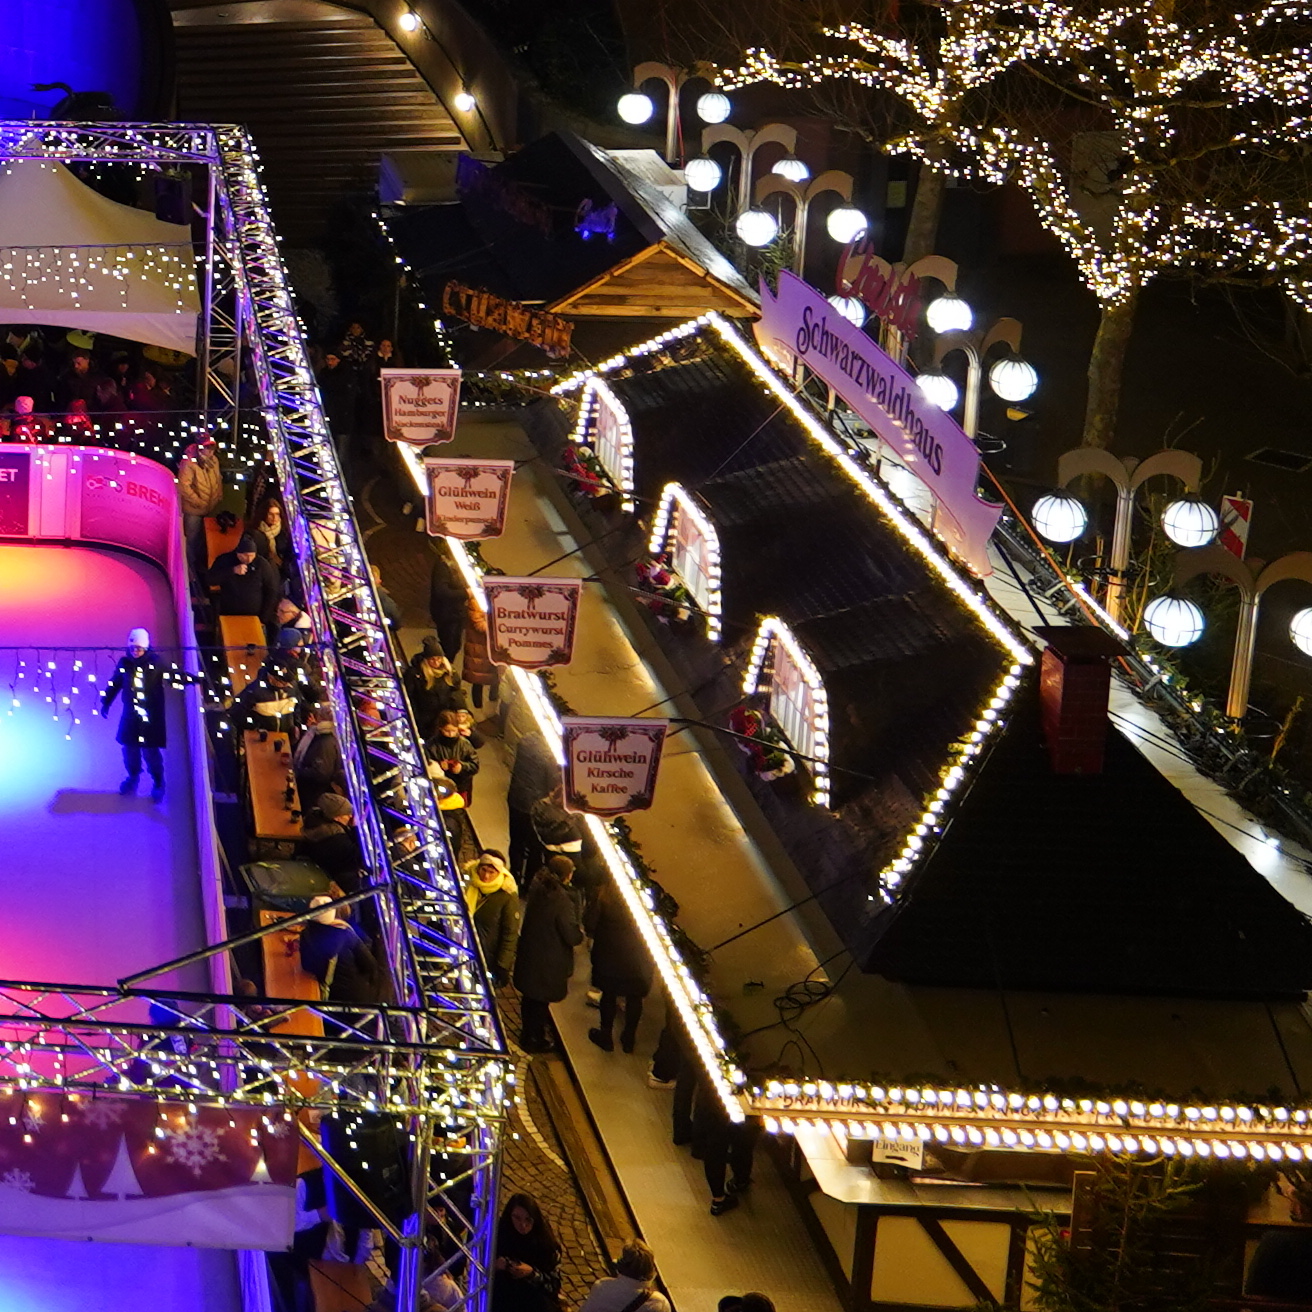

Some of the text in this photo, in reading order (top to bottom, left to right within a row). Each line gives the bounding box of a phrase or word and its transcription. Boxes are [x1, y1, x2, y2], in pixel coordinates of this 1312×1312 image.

[796, 305, 944, 477] Schwarzwaldhaus
[397, 394, 444, 408] Nuggets
[394, 408, 447, 419] Hamburger
[438, 486, 497, 500] Glühwein
[454, 500, 481, 511] Weiß
[497, 606, 567, 622] Bratwurst
[498, 624, 565, 637] Currywurst
[508, 638, 554, 649] Pommes
[576, 750, 648, 765] Glühwein
[587, 767, 635, 779] Kirsche
[591, 783, 629, 795] Kaffee
[876, 1140, 921, 1157] Eingang
